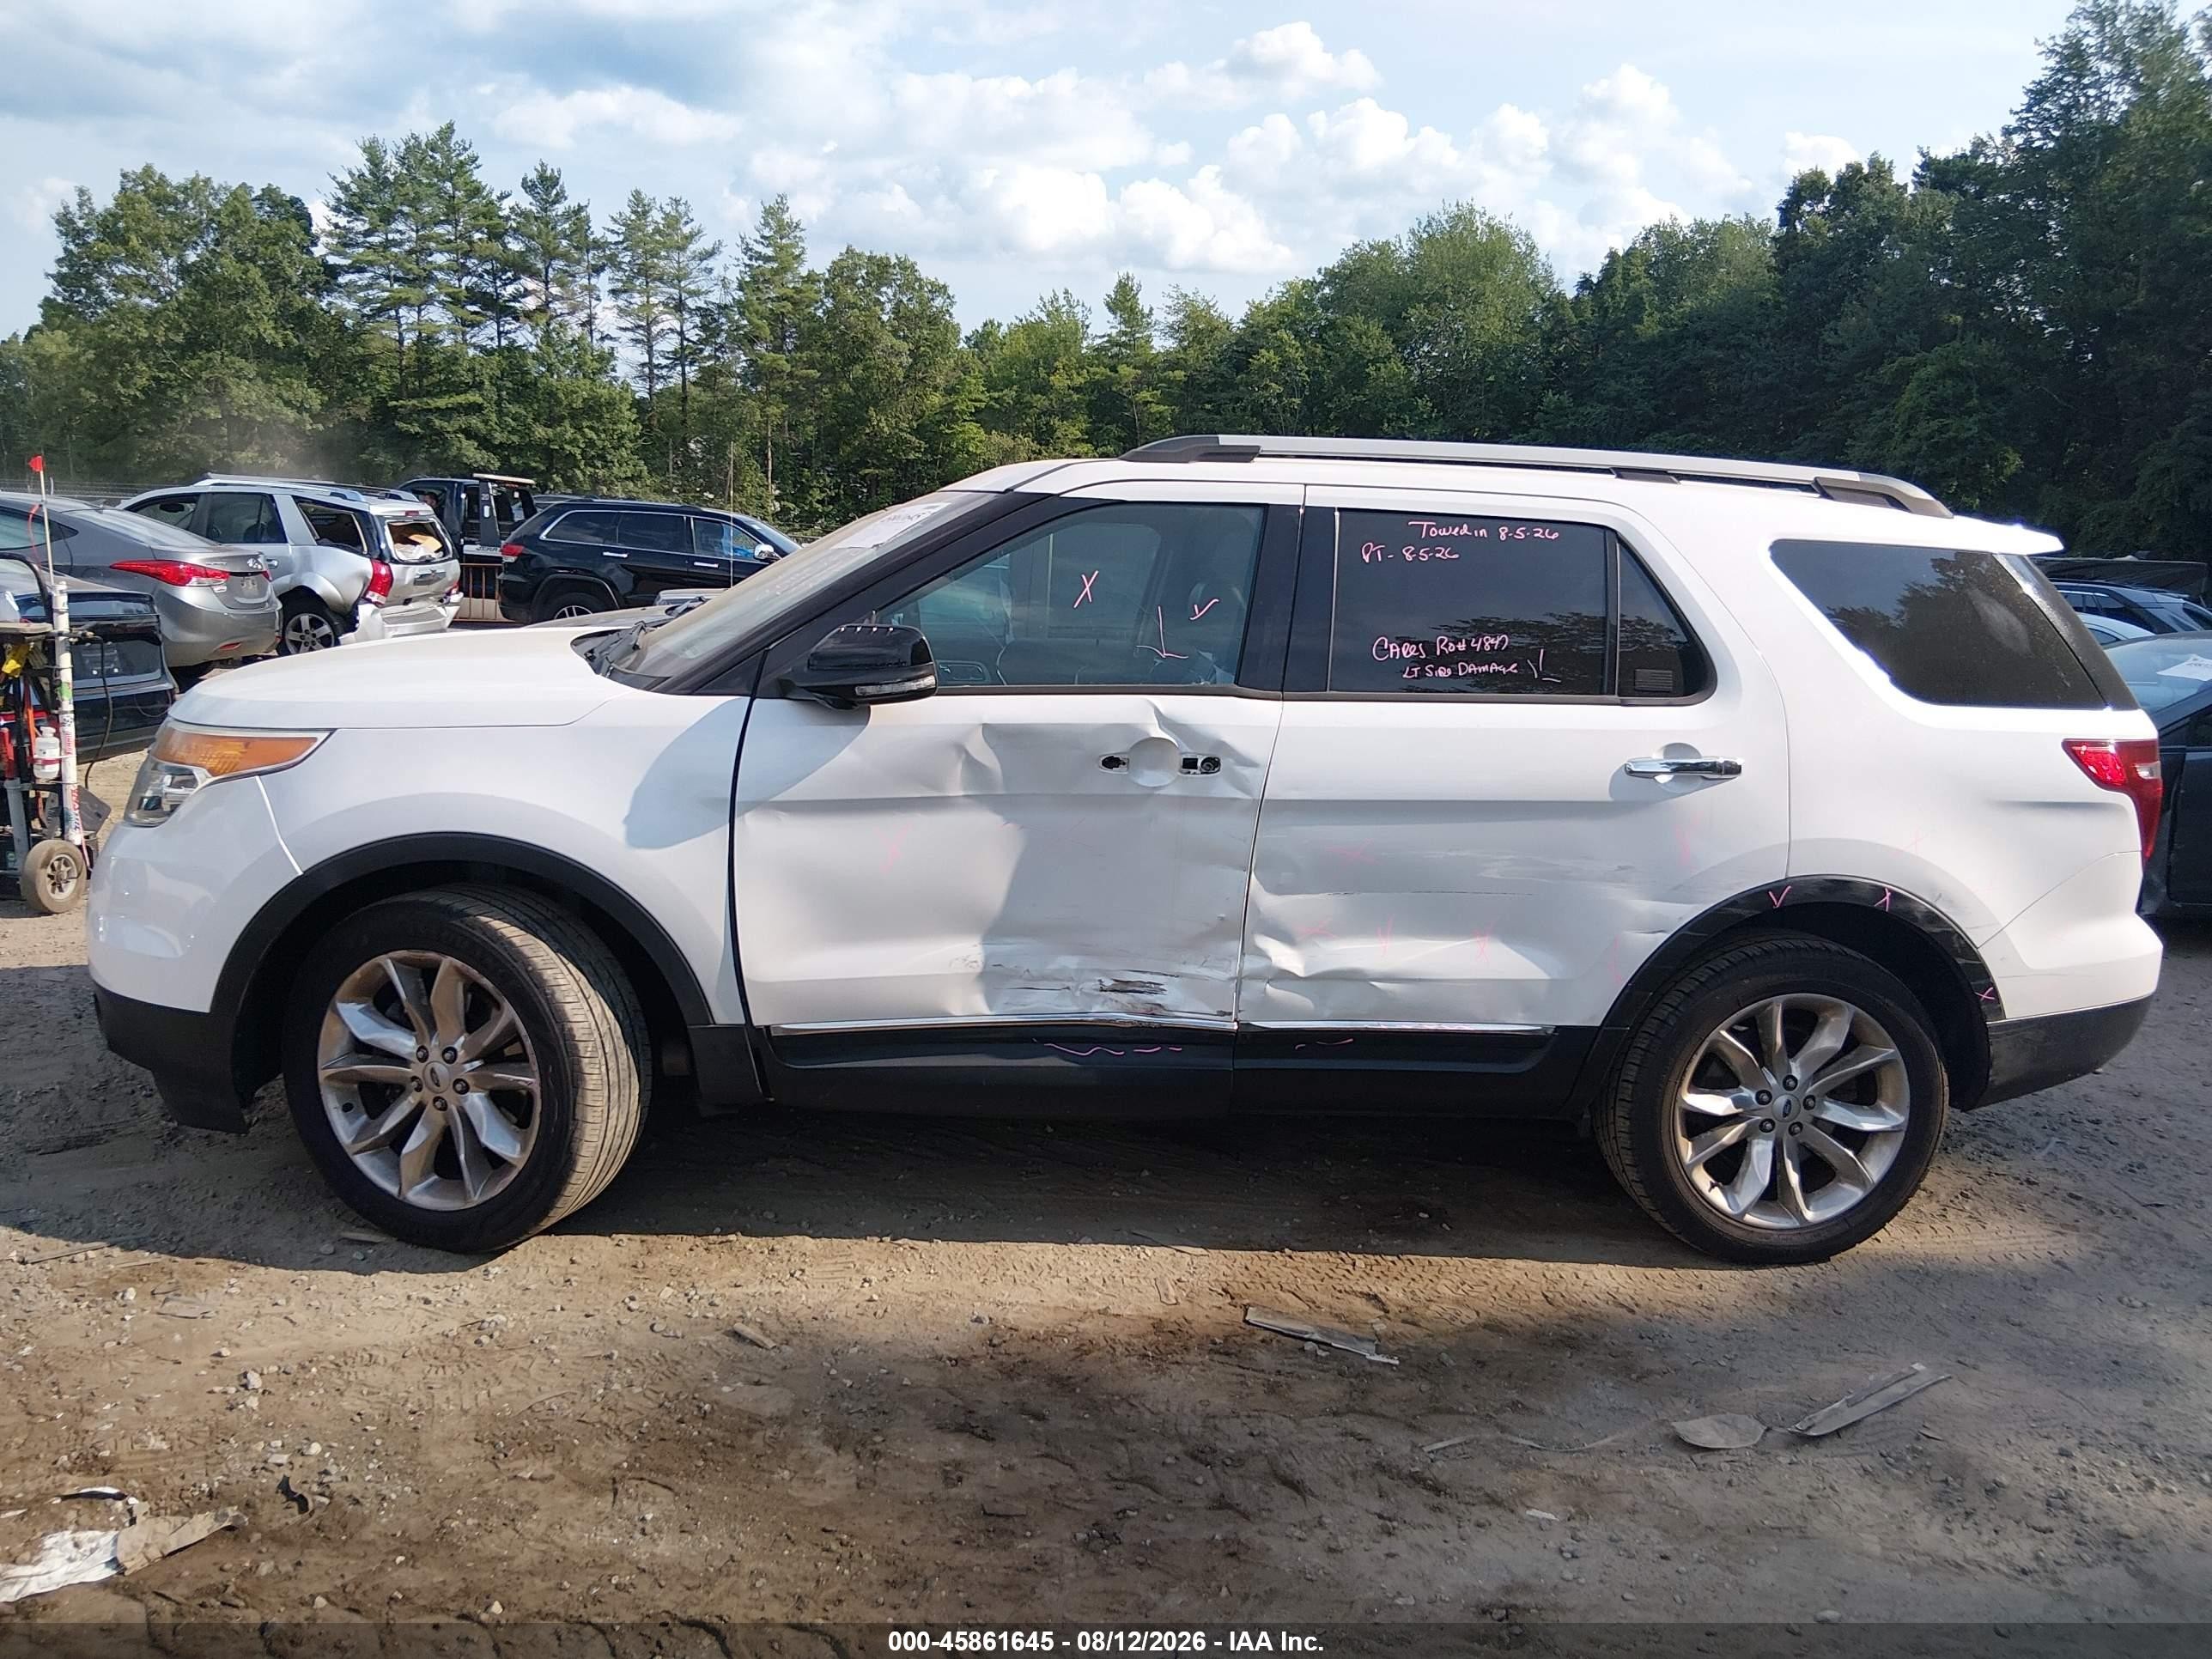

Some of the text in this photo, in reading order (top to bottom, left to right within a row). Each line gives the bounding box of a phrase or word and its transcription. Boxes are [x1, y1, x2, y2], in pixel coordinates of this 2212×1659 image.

[1407, 521, 1559, 541] Towed in 8-5-26
[1401, 545, 1460, 562] 8-5-26
